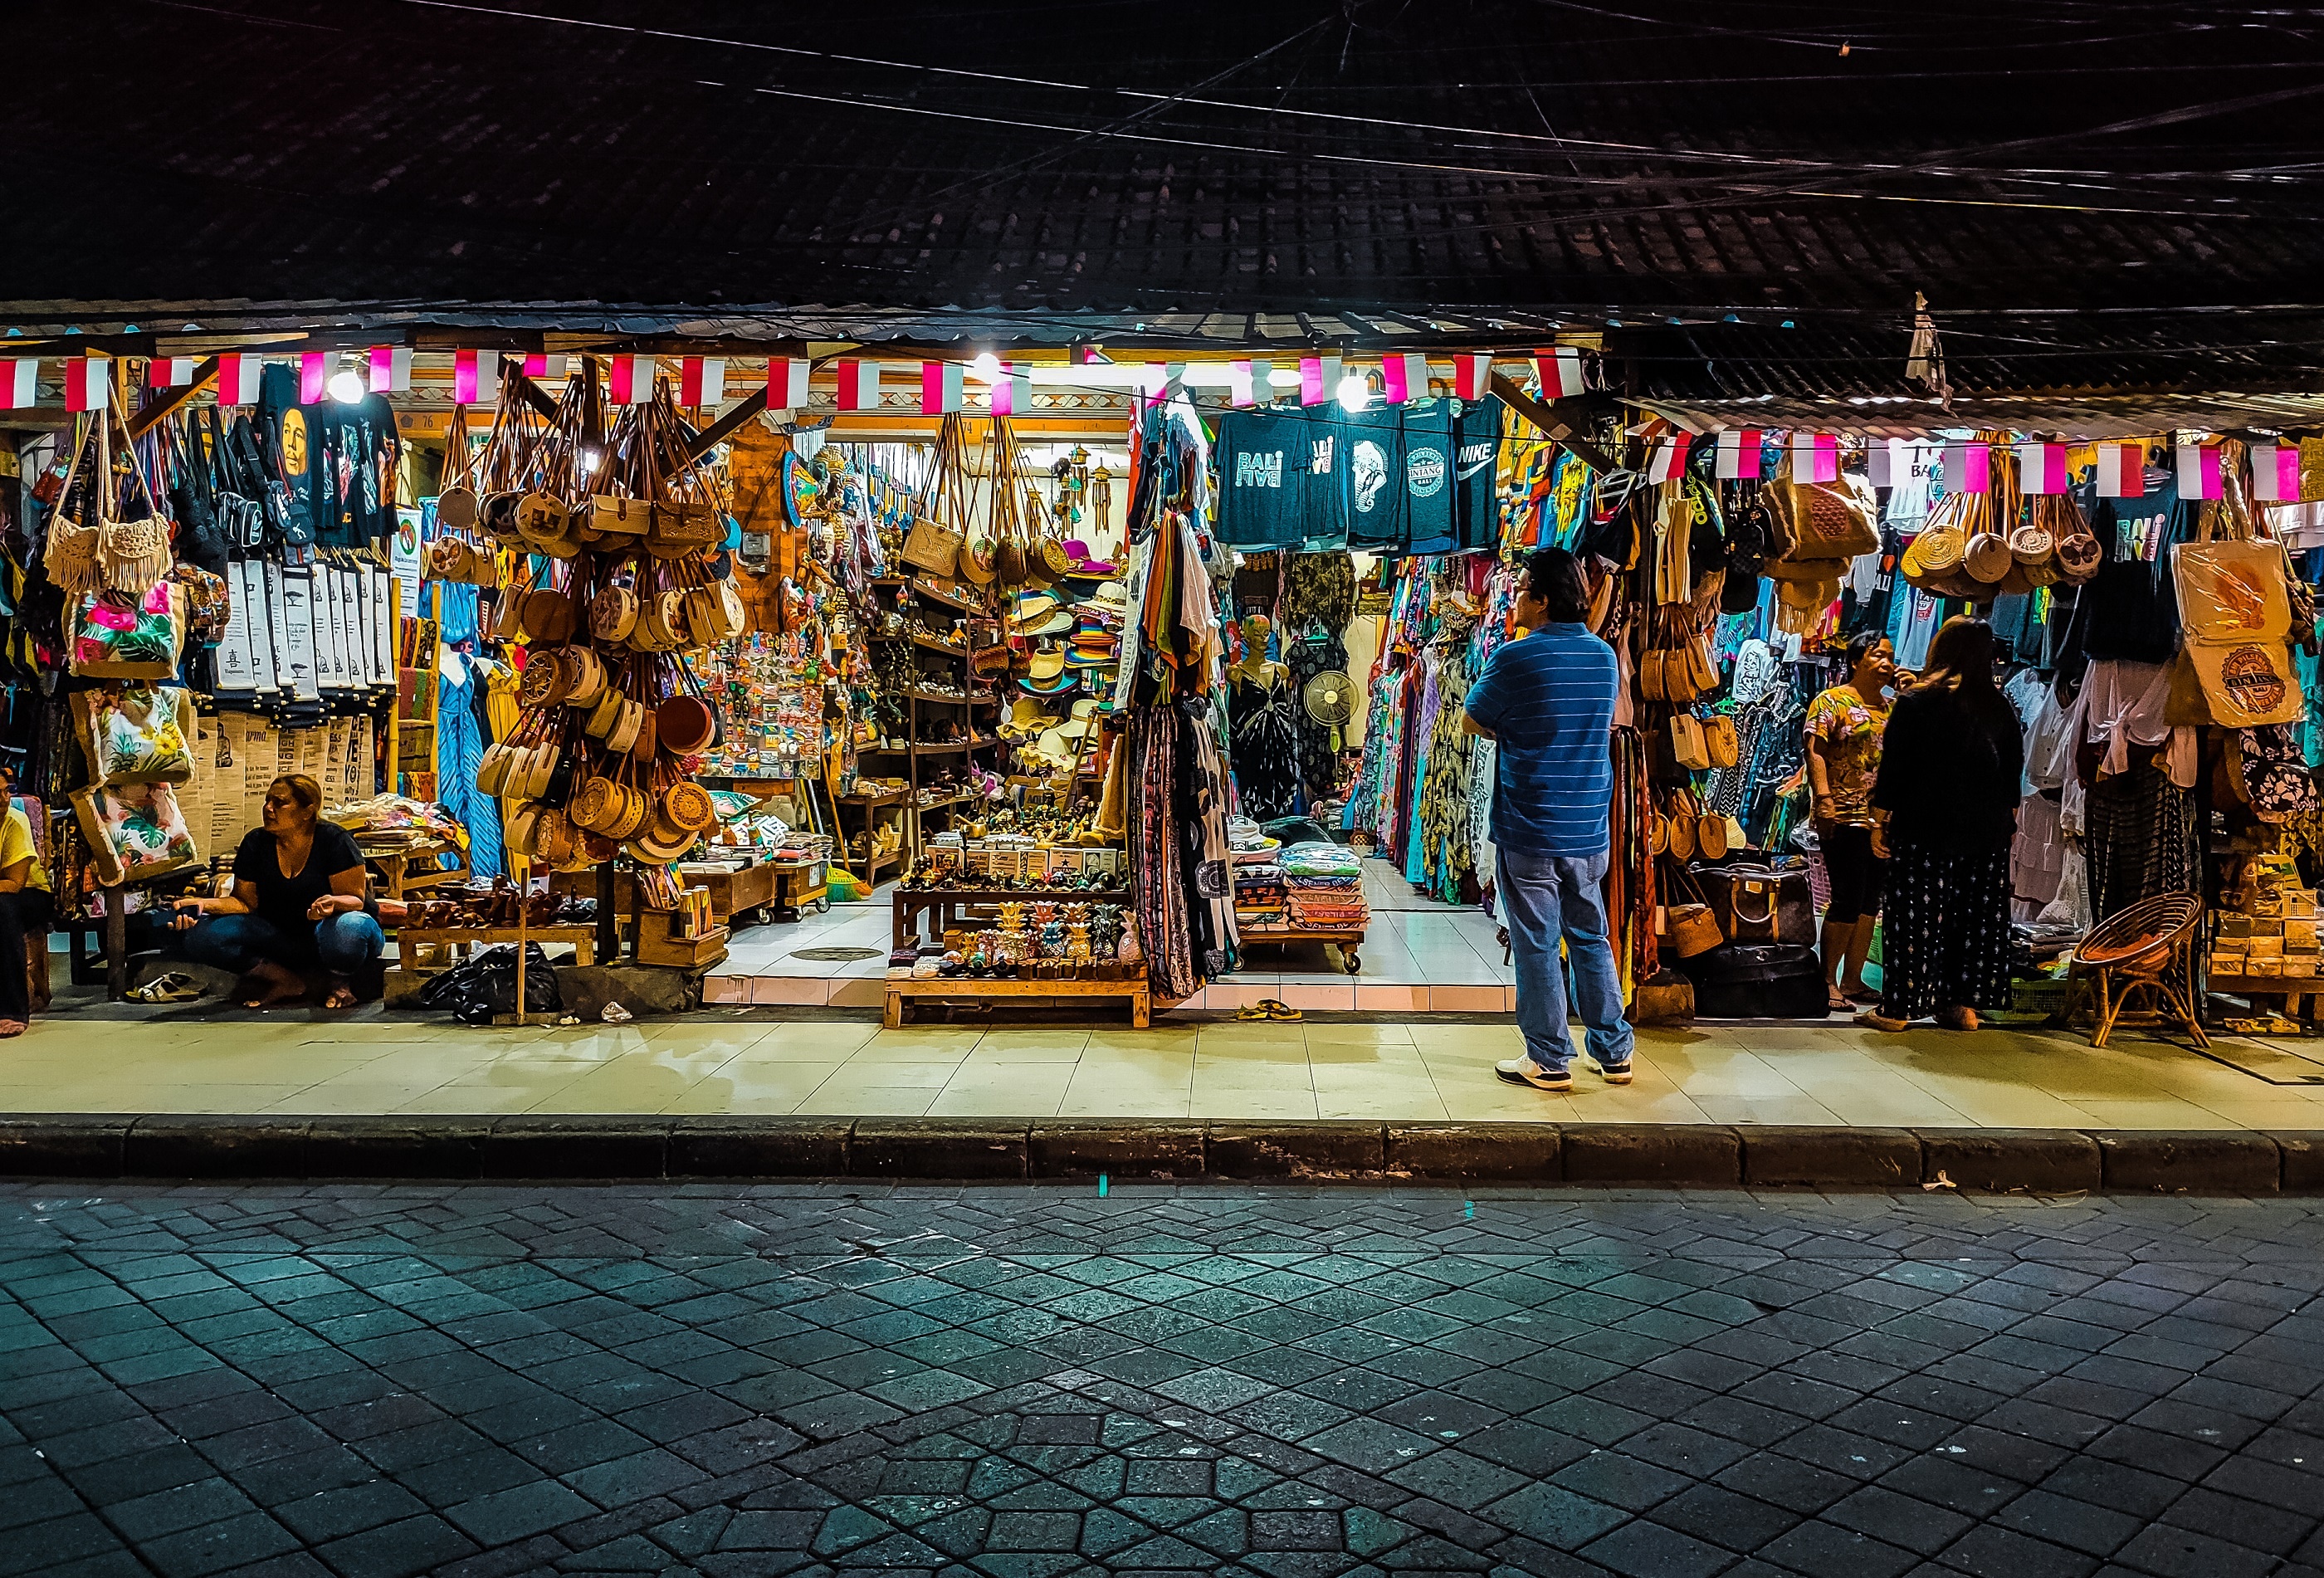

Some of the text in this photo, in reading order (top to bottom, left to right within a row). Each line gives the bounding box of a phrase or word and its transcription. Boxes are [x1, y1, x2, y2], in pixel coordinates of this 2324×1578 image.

[422, 415, 433, 427] 76
[1458, 442, 1492, 462] NIKE
[1911, 465, 1928, 477] BA
[226, 649, 241, 668] 喜
